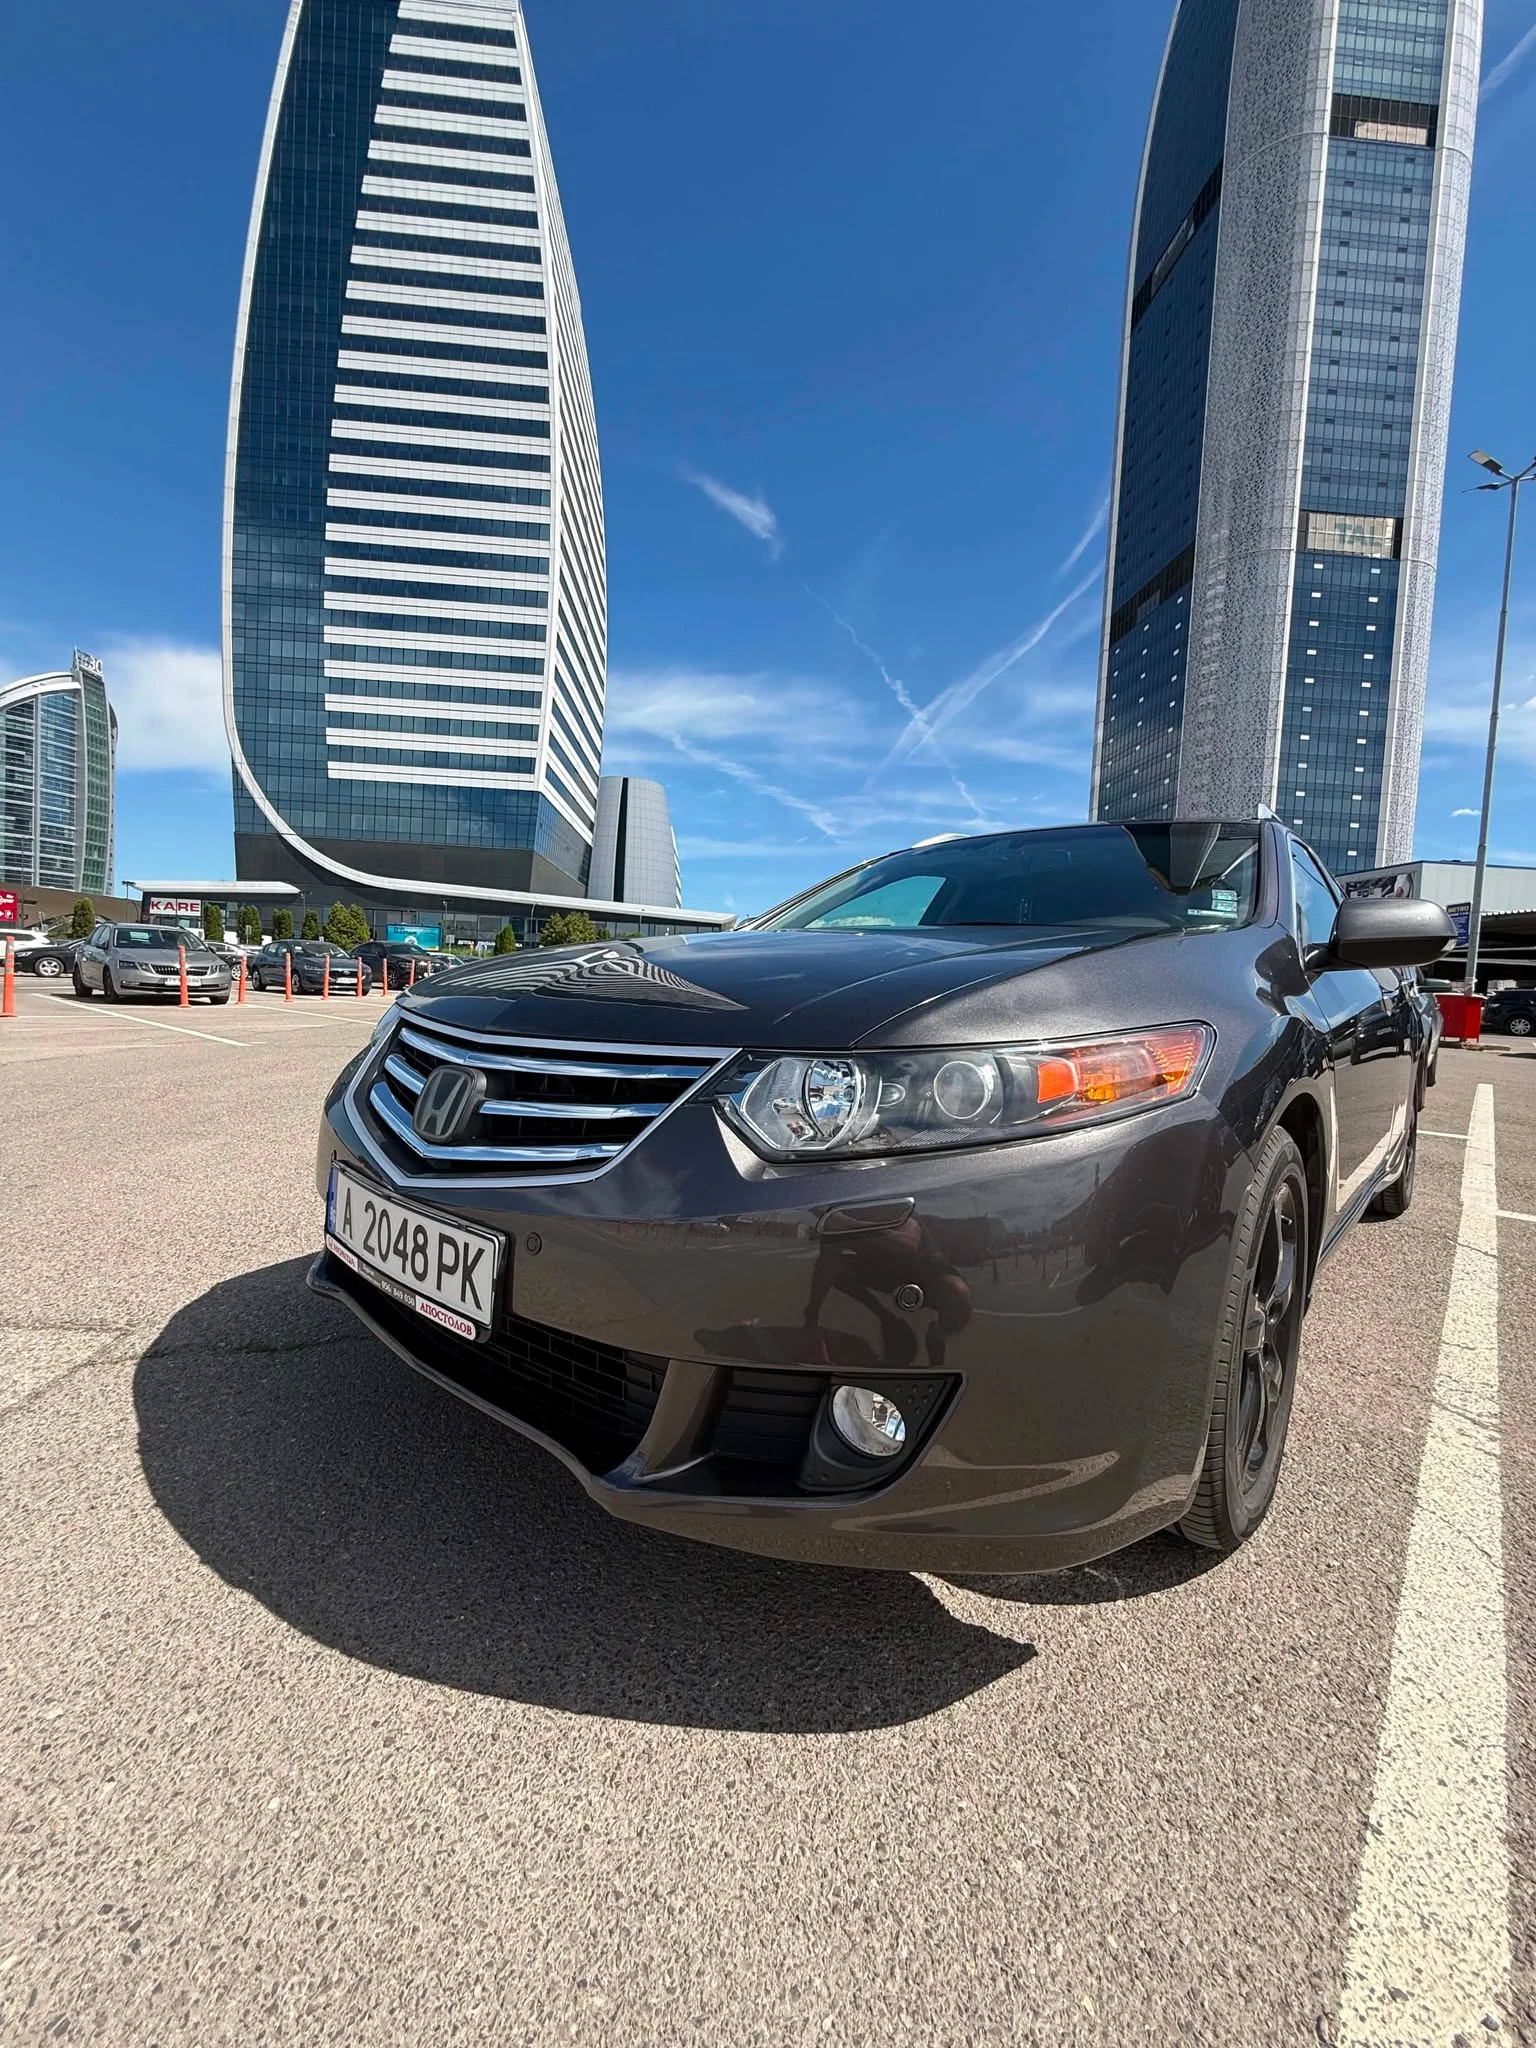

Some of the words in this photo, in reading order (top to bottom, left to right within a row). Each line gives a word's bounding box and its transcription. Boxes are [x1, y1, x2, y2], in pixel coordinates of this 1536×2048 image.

[151, 901, 200, 912] KARE
[342, 1187, 353, 1240] A
[363, 1200, 429, 1282] 2048
[436, 1232, 485, 1312] PK
[420, 1302, 473, 1336] АПОСТОЛОВ
